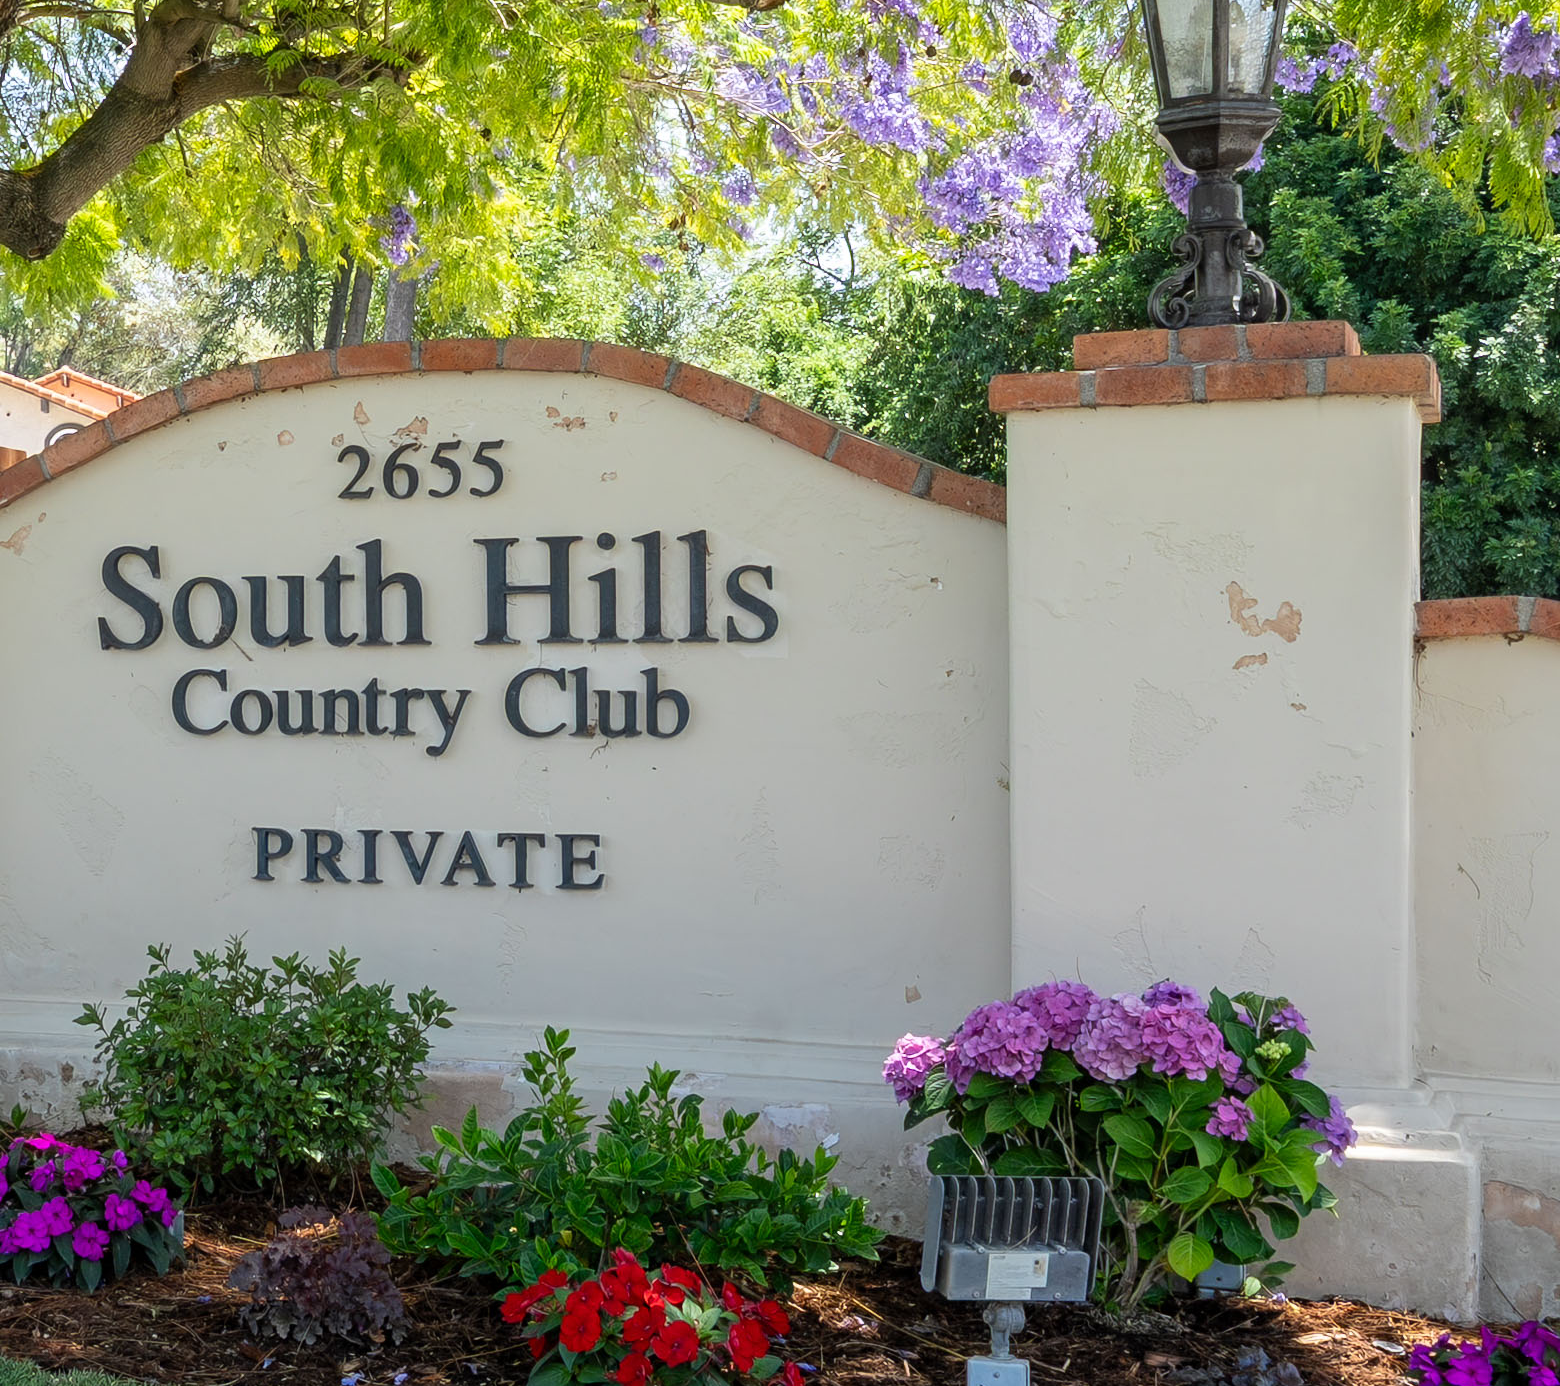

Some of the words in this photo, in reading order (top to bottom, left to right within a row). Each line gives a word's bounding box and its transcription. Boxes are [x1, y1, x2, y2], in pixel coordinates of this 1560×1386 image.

[337, 439, 506, 501] 2655
[98, 538, 433, 651] South
[473, 529, 780, 646] Hills
[171, 668, 472, 758] Country
[505, 666, 692, 739] Club
[251, 826, 606, 892] PRIVATE
